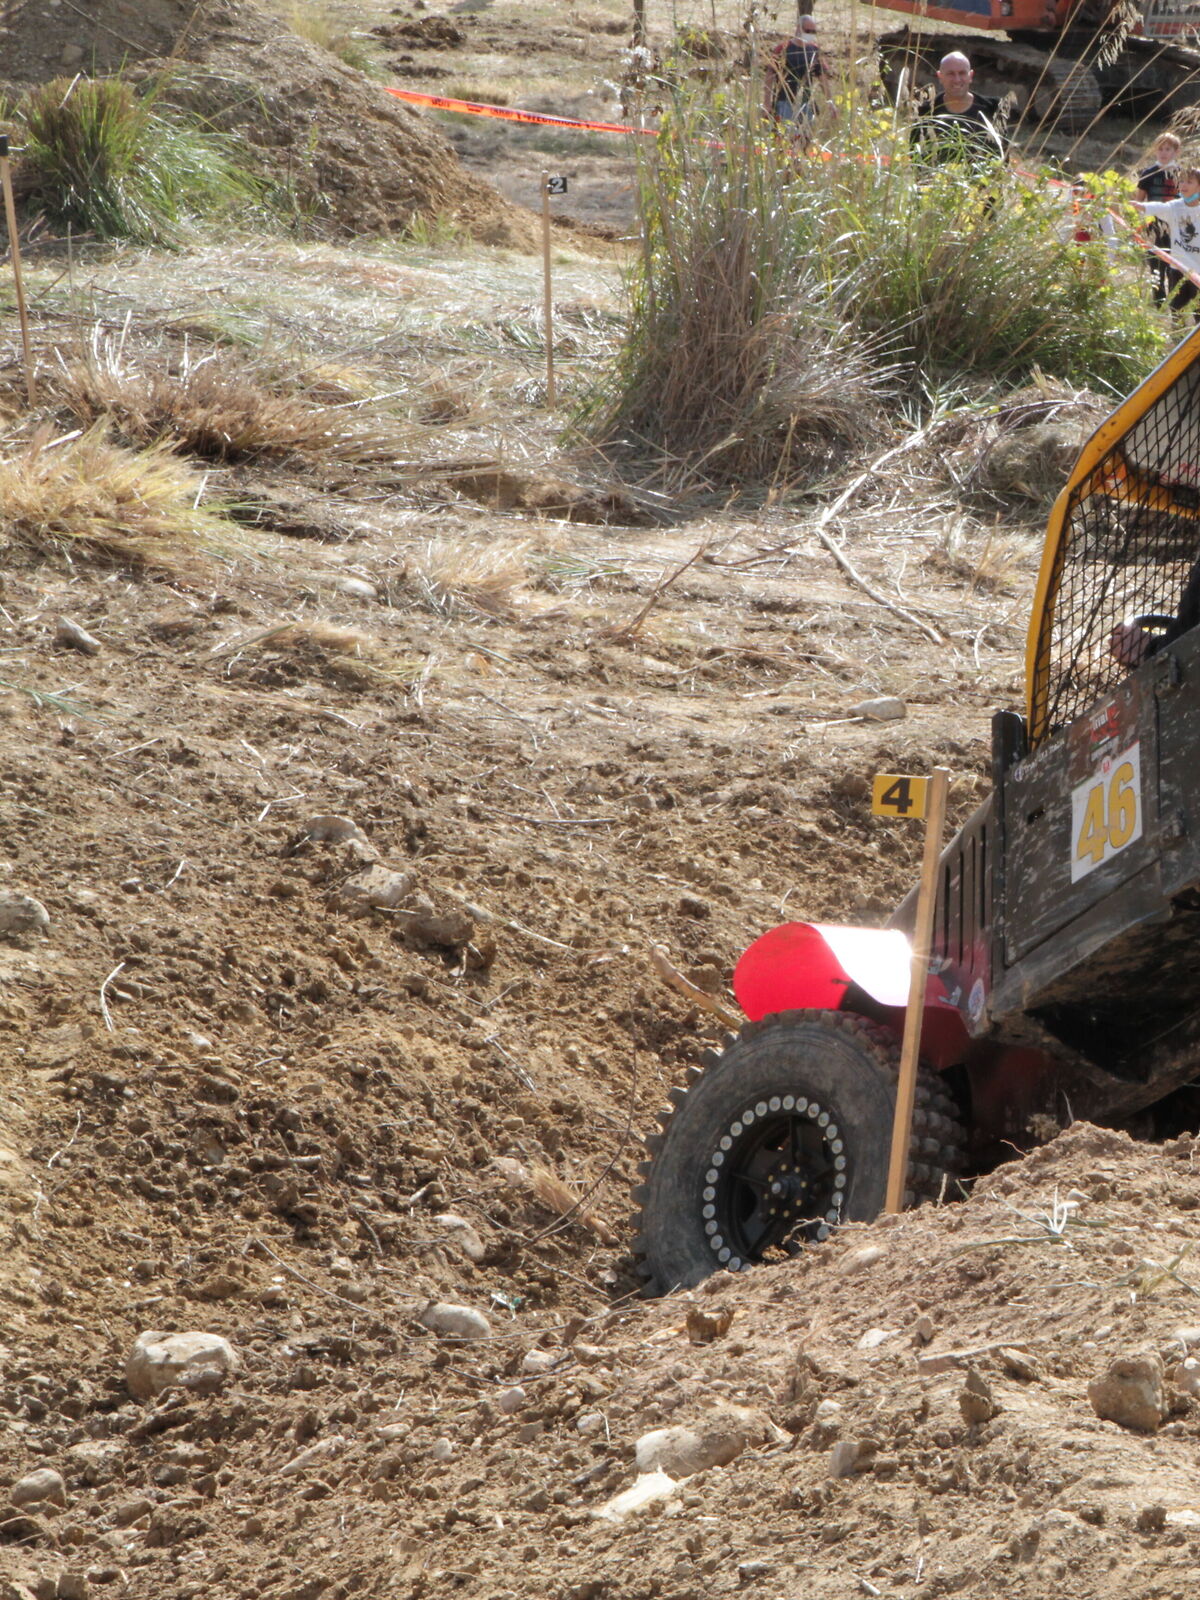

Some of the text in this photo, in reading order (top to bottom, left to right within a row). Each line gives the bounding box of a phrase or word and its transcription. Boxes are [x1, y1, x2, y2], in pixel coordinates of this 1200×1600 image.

[551, 178, 565, 193] 2
[880, 777, 913, 813] 4
[1076, 761, 1137, 865] 46
